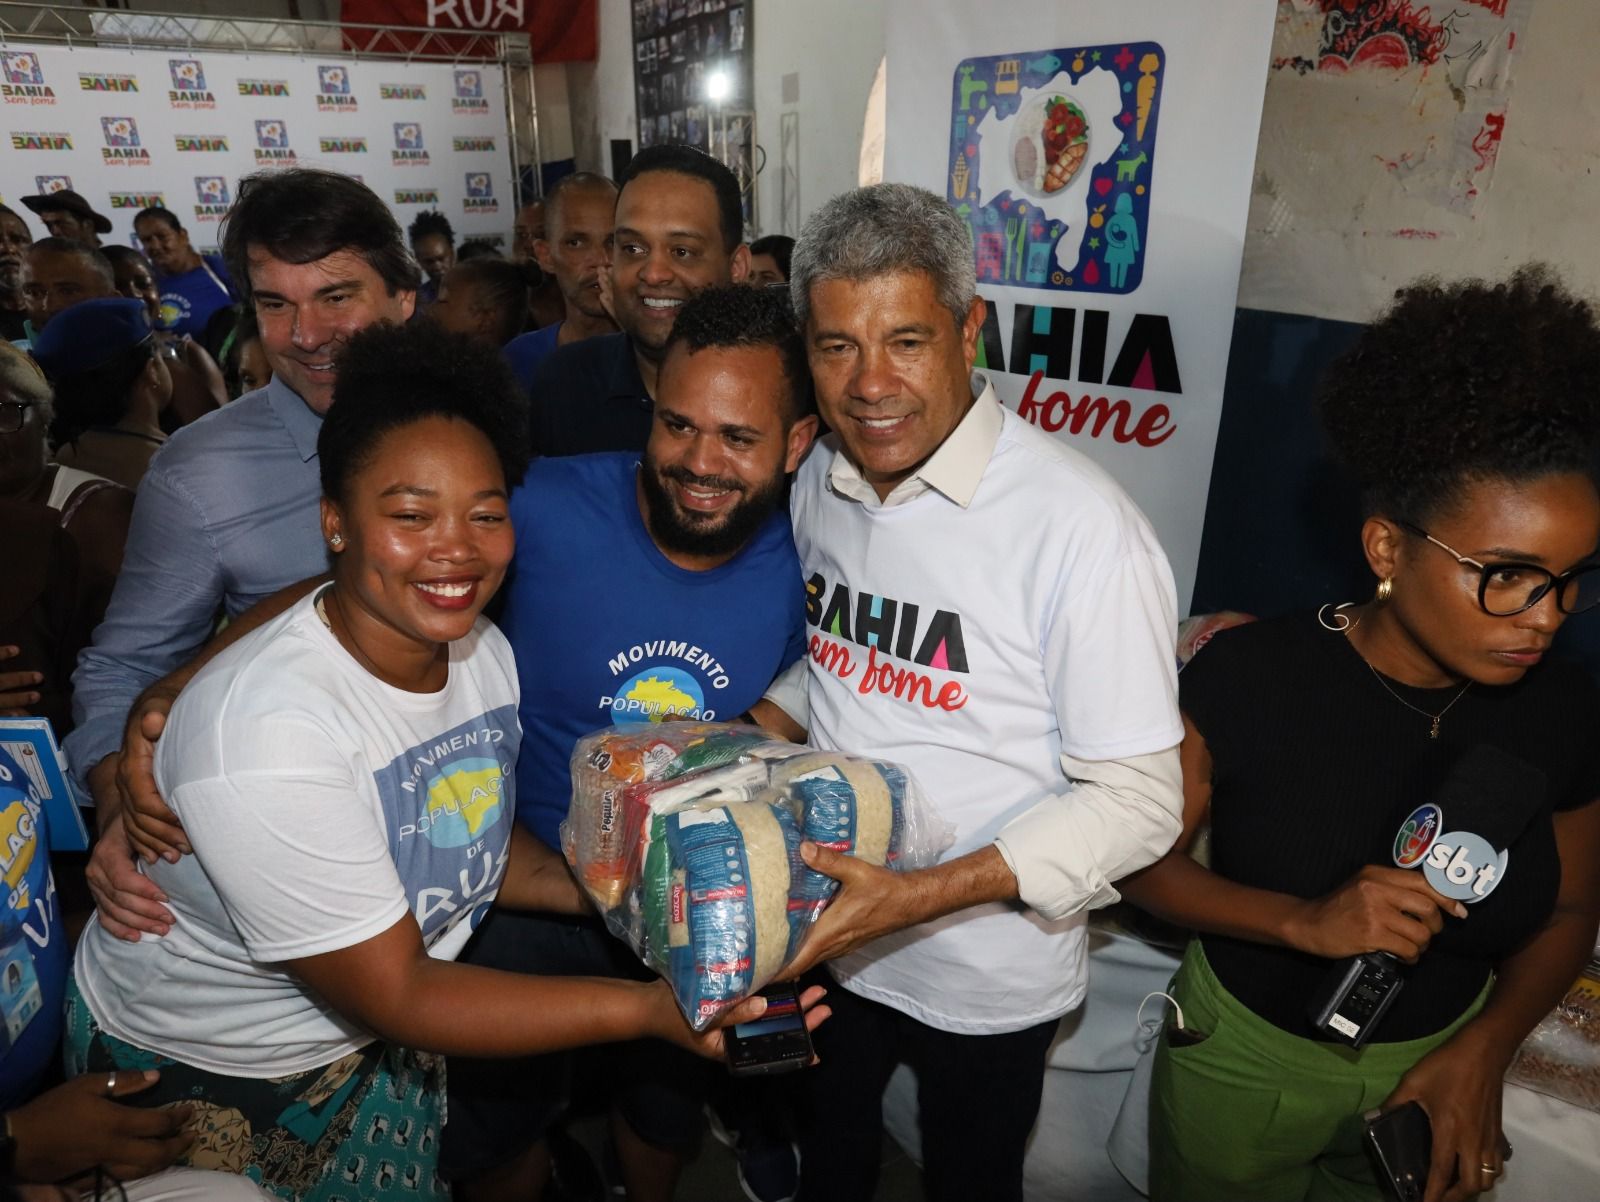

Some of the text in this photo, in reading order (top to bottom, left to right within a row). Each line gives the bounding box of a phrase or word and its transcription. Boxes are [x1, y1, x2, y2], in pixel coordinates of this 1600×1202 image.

[1, 85, 55, 97] BAHIA
[80, 78, 138, 92] BAHIA
[238, 83, 290, 96] BAHIA
[169, 91, 215, 102] BAHIA
[316, 95, 357, 105] BAHIA
[380, 87, 426, 100] BAHIA
[452, 98, 489, 108] BAHIA
[12, 137, 73, 150] BAHIA
[176, 139, 229, 151] BAHIA
[320, 141, 368, 152] BAHIA
[102, 148, 150, 158] BAHIA
[255, 149, 297, 159] BAHIA
[392, 150, 430, 160] BAHIA
[111, 195, 165, 208] BAHIA
[463, 198, 498, 208] BAHIA
[973, 300, 1183, 394] AHIA
[1018, 369, 1177, 447] fome
[806, 572, 970, 674] BAHIA
[608, 640, 729, 689] MOVIMENTO
[808, 634, 969, 712] em fome
[466, 839, 485, 859] DE
[1426, 843, 1497, 896] sbt
[8, 878, 29, 909] DE
